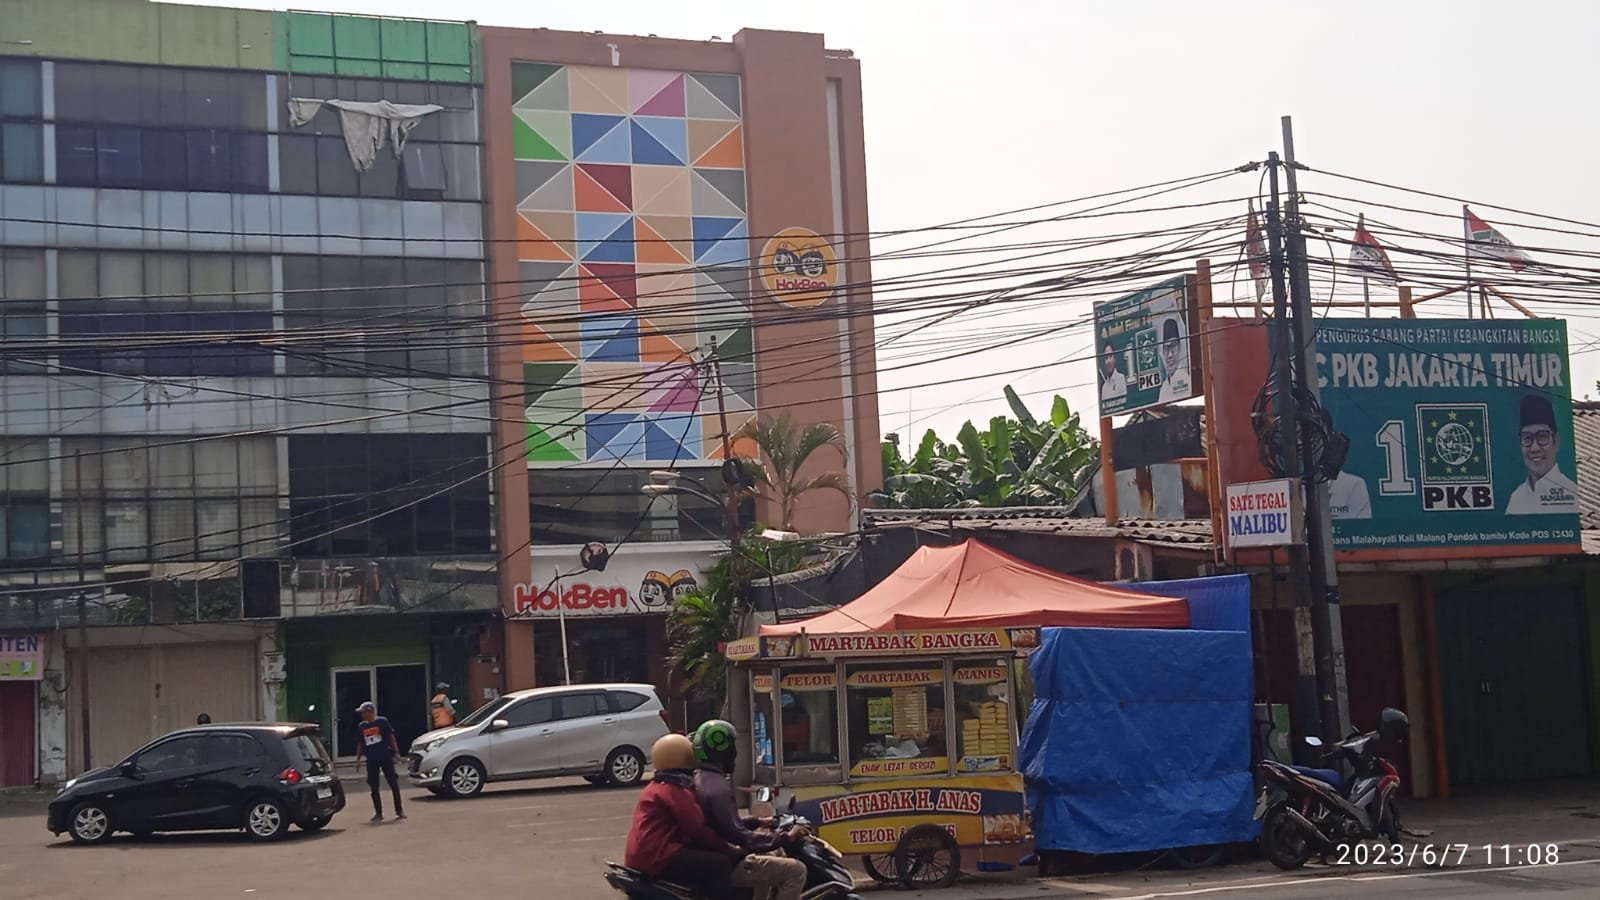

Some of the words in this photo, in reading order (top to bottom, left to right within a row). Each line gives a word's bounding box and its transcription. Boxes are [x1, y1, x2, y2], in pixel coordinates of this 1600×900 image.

[776, 279, 827, 291] HokBen
[1316, 329, 1370, 344] PENGURUS
[1373, 328, 1414, 344] CABANG
[1416, 329, 1451, 344] PARTAI
[1453, 328, 1520, 344] KEBANGKITAN
[1523, 329, 1561, 344] BANGSA
[1331, 352, 1379, 388] PKB
[1384, 352, 1489, 388] JAKARTA
[1491, 352, 1564, 388] TIMUR
[1140, 374, 1161, 389] PKB
[1377, 421, 1416, 496] 1
[1230, 494, 1254, 511] SATE
[1255, 492, 1287, 510] TEGAL
[1423, 486, 1493, 509] PKB
[1230, 513, 1287, 536] MALIBU
[1352, 534, 1397, 545] Malahayati
[1398, 533, 1415, 543] Kali
[1416, 533, 1446, 544] Malang
[1531, 530, 1550, 539] POS
[515, 583, 628, 612] HokBen
[809, 636, 917, 651] MARTABAK
[921, 632, 1000, 649] BANGKA
[786, 675, 832, 687] TELOR
[858, 671, 931, 684] MARTABAK
[957, 668, 1001, 680] MANIS
[883, 762, 905, 772] LEZAT
[821, 790, 914, 822] MARTABAK
[916, 789, 934, 811] H.
[937, 790, 981, 813] ANAS
[849, 828, 897, 844] TELOR
